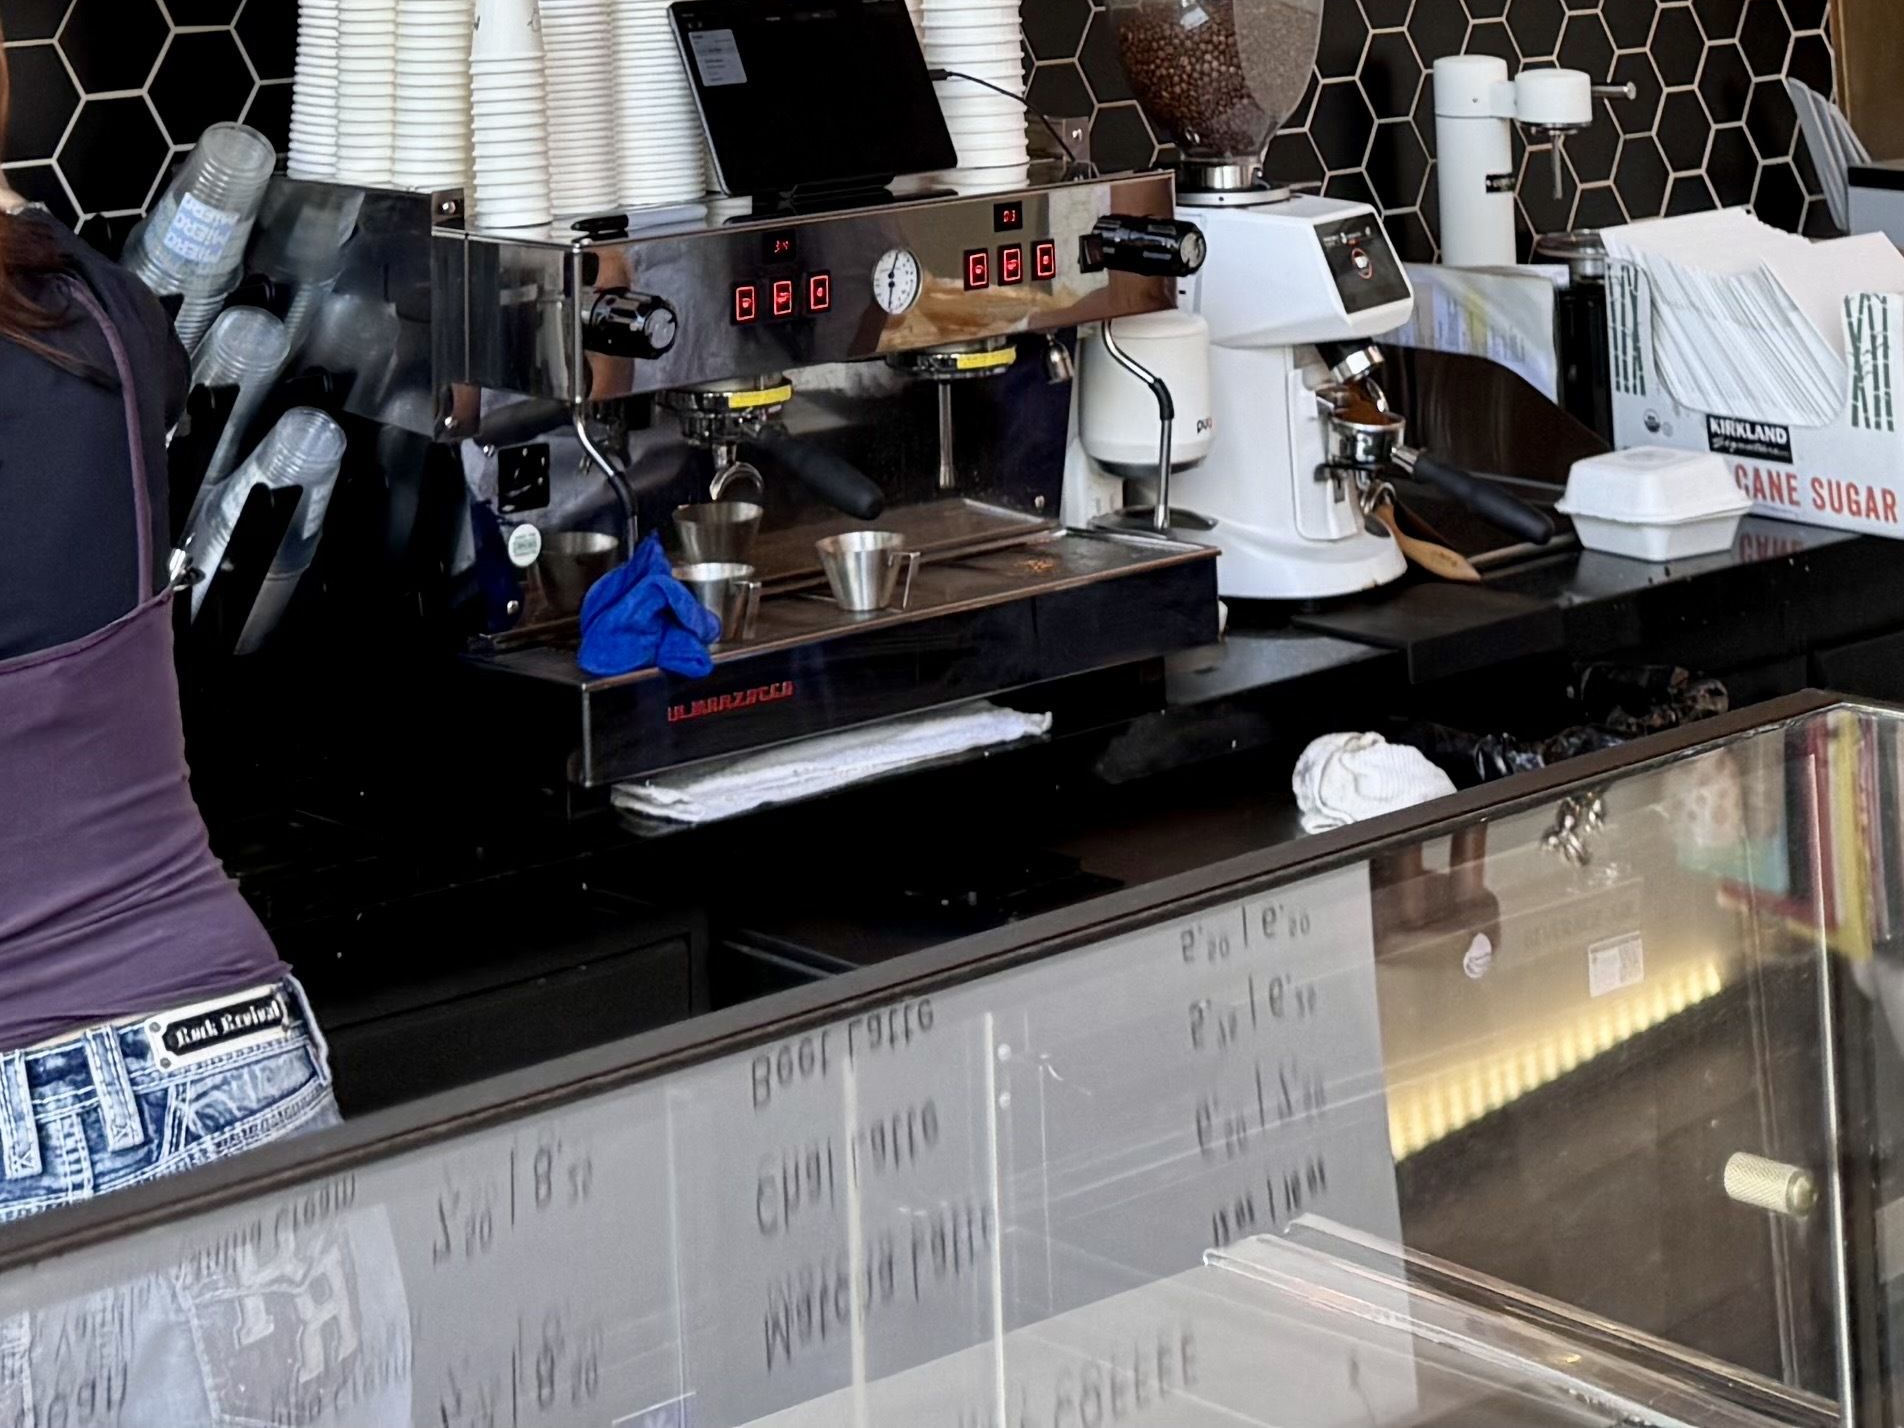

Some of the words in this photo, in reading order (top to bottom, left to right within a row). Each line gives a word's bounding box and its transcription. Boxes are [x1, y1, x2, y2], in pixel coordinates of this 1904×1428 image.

[1709, 416, 1788, 445] KIRKLAND
[1734, 463, 1801, 507] CANE
[1810, 476, 1899, 524] SUGAR
